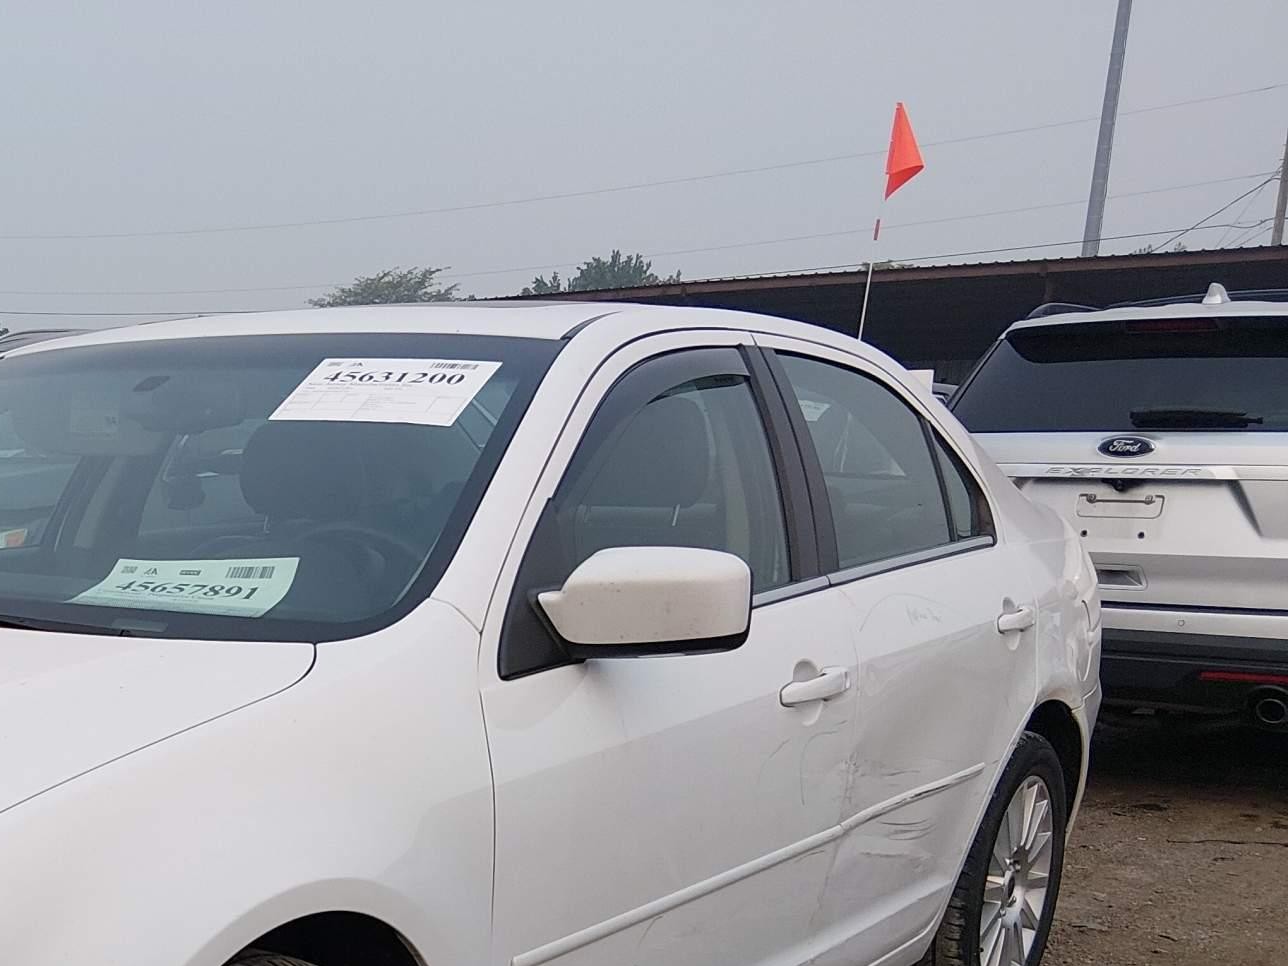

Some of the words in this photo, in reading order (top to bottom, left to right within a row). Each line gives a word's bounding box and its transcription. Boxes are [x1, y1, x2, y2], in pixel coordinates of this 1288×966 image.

[323, 370, 466, 385] 45631200
[1108, 439, 1142, 453] Ford
[1045, 466, 1202, 477] EXPLORER
[114, 579, 260, 601] 45657891
